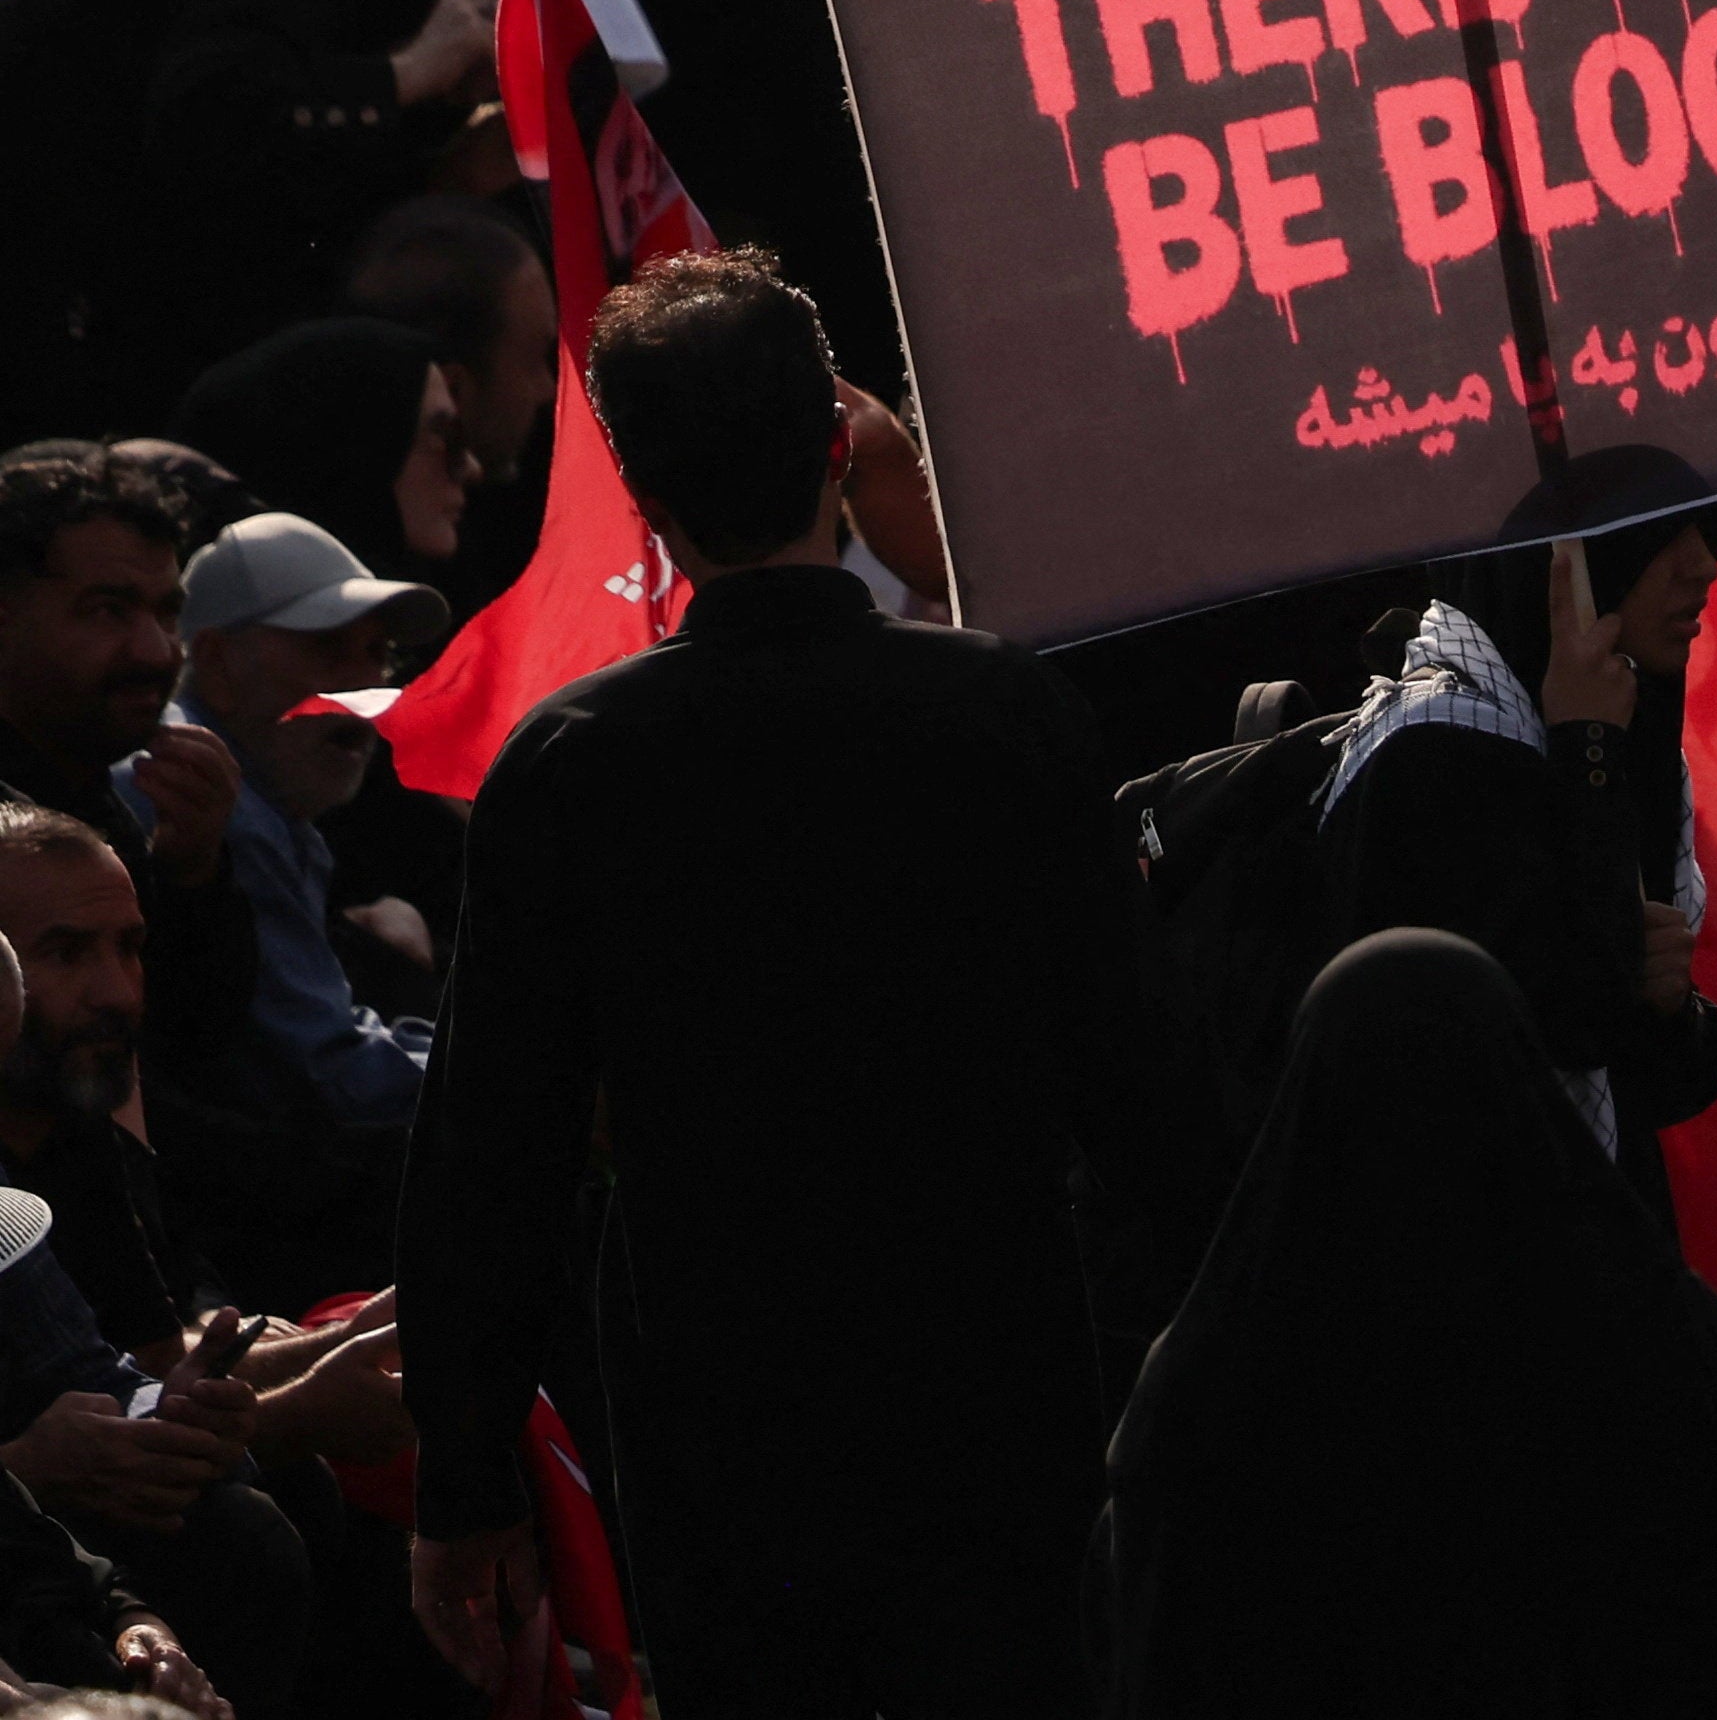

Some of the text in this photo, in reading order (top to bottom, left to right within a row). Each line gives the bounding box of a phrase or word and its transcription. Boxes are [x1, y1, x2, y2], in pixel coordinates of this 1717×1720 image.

[1101, 105, 1351, 380] BE
[1294, 366, 1494, 459] میشه
[1571, 325, 1639, 415] به
